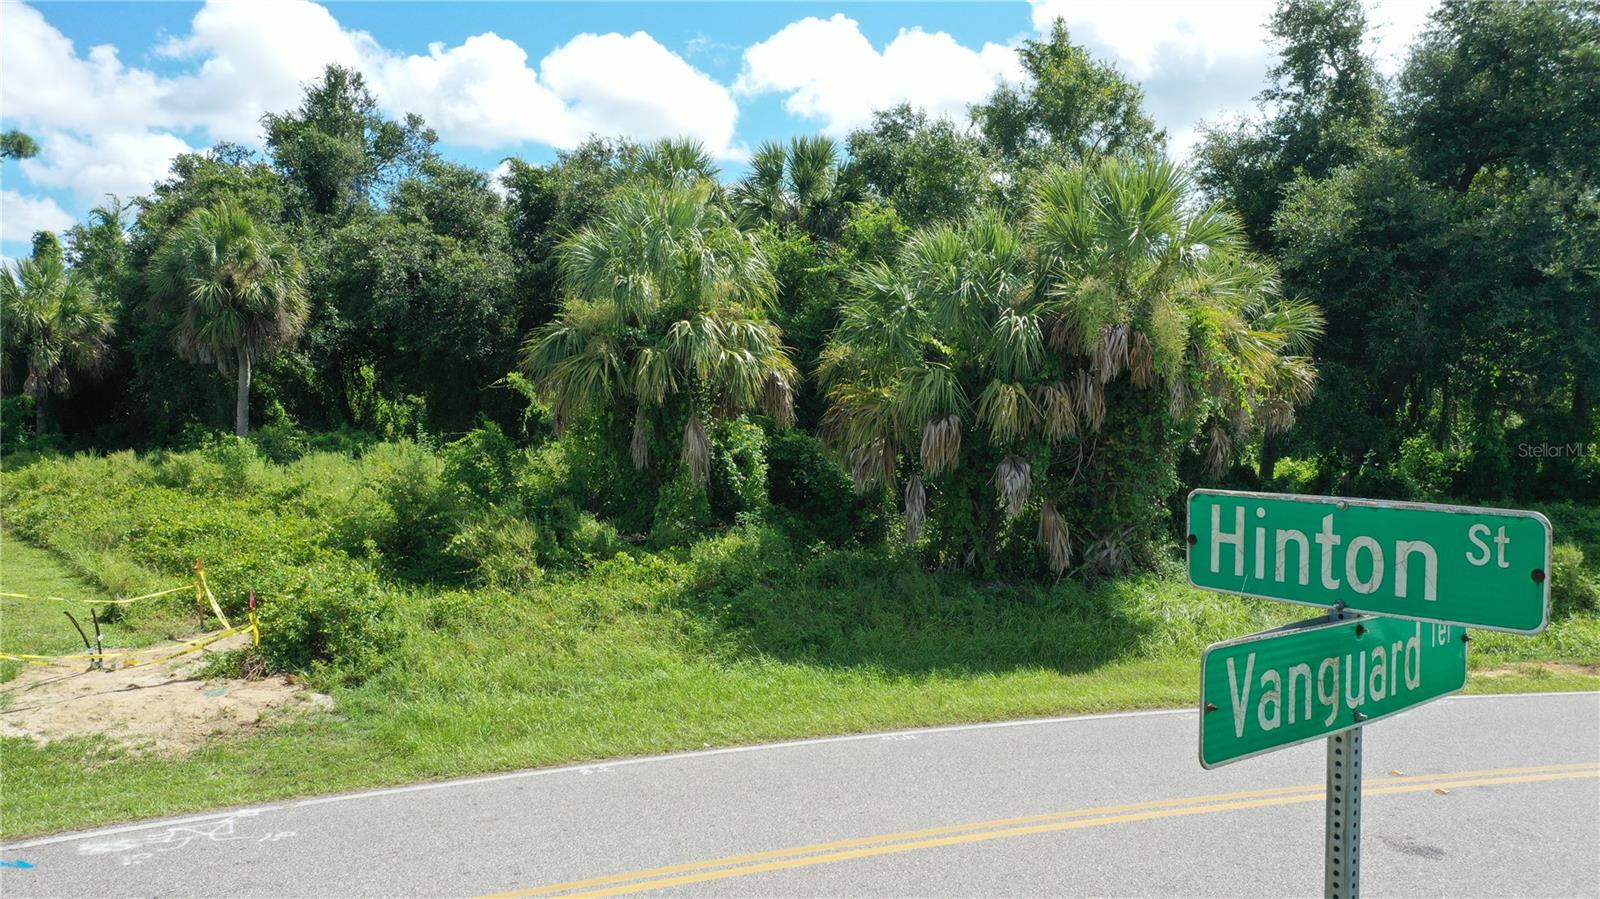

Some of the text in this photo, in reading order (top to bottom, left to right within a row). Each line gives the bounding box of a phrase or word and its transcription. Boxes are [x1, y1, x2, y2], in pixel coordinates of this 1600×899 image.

[1210, 504, 1510, 601] Hinton St
[1226, 621, 1421, 738] Vanguard
